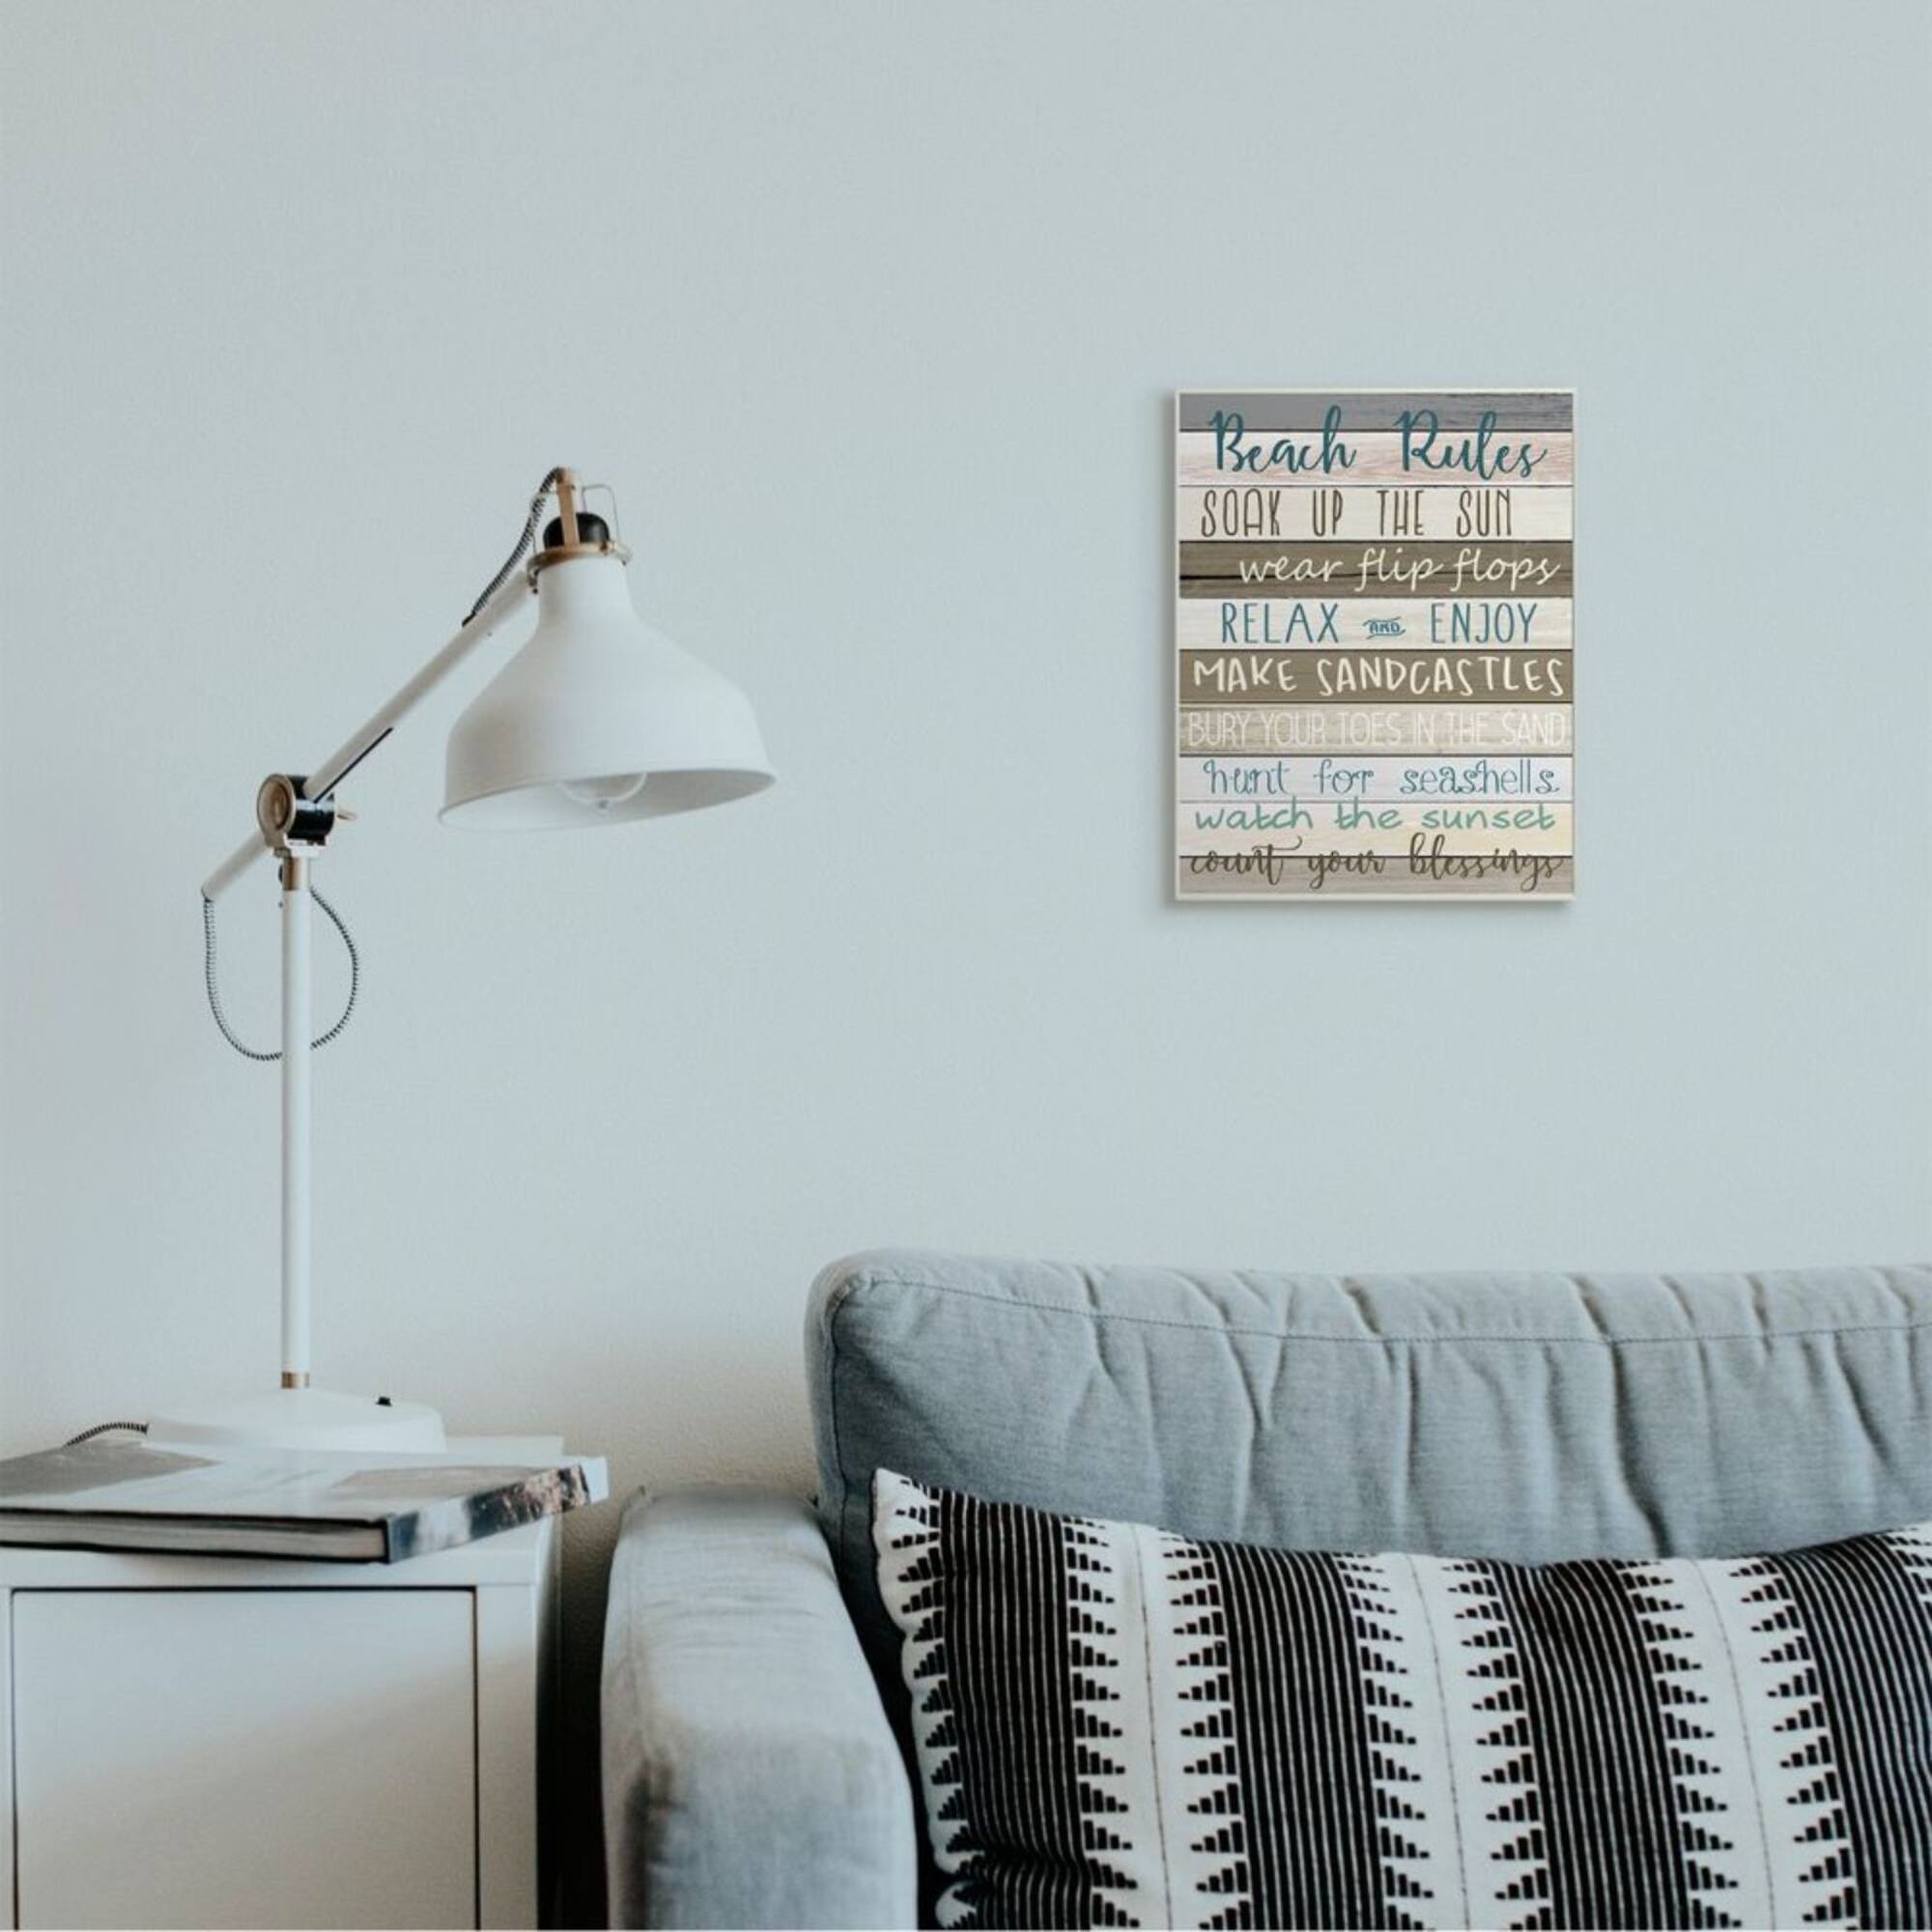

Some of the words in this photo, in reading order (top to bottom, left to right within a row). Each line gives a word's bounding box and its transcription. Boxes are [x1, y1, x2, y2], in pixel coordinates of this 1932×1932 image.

[1208, 406, 1357, 474] Beach
[1394, 409, 1548, 480] Rules
[1201, 489, 1281, 537] SOAK
[1313, 490, 1344, 536] UP
[1377, 490, 1424, 536] THE
[1457, 489, 1512, 536] SUN
[1238, 554, 1343, 583] wear
[1354, 548, 1444, 591] flip
[1451, 548, 1561, 591] flops
[1222, 602, 1339, 643] RELAX
[1367, 619, 1403, 636] AND
[1431, 603, 1538, 643] ENJOY
[1193, 657, 1296, 694] MAKE
[1317, 656, 1564, 696] SANDCASTLES
[1189, 711, 1255, 748] BURY
[1259, 711, 1324, 748] YOUR
[1337, 711, 1402, 746] TOES
[1413, 712, 1435, 747] IN
[1446, 712, 1494, 746] THE
[1500, 711, 1566, 747] SAND
[1203, 759, 1290, 795] hunt
[1314, 759, 1375, 795] for
[1400, 759, 1561, 795] seashells
[1195, 796, 1313, 831] watch
[1334, 800, 1403, 831] the
[1421, 802, 1556, 831] sunset
[1190, 836, 1303, 886] count
[1307, 849, 1385, 890] your
[1409, 832, 1564, 893] blessings
